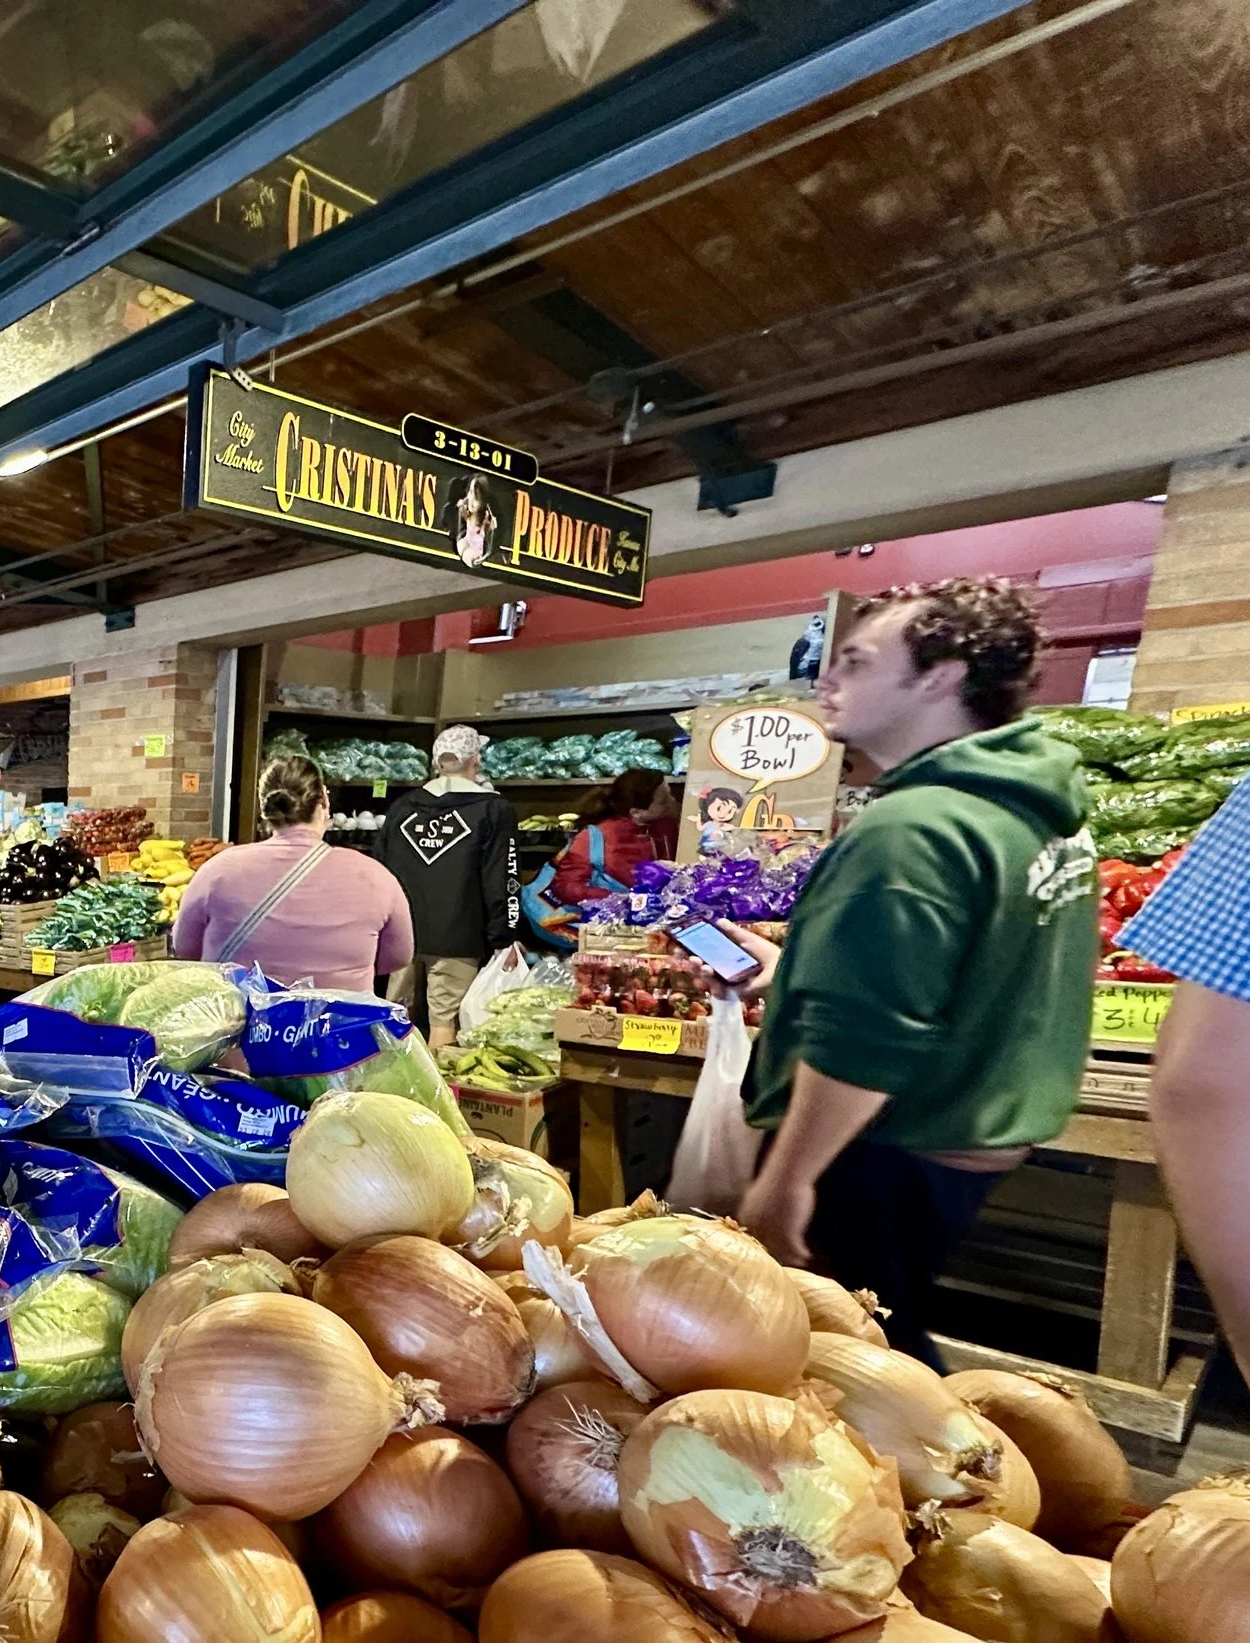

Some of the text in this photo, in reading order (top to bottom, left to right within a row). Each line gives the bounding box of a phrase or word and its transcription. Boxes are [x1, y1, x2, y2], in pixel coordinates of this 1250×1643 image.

[230, 411, 255, 447] City
[215, 444, 264, 473] Market
[434, 431, 512, 471] 3-13-01
[274, 412, 612, 573] CRISTINA'S PRODUCE
[787, 731, 814, 748] per
[740, 748, 796, 770] Bowl
[419, 838, 444, 848] CREW
[508, 896, 520, 929] CREW
